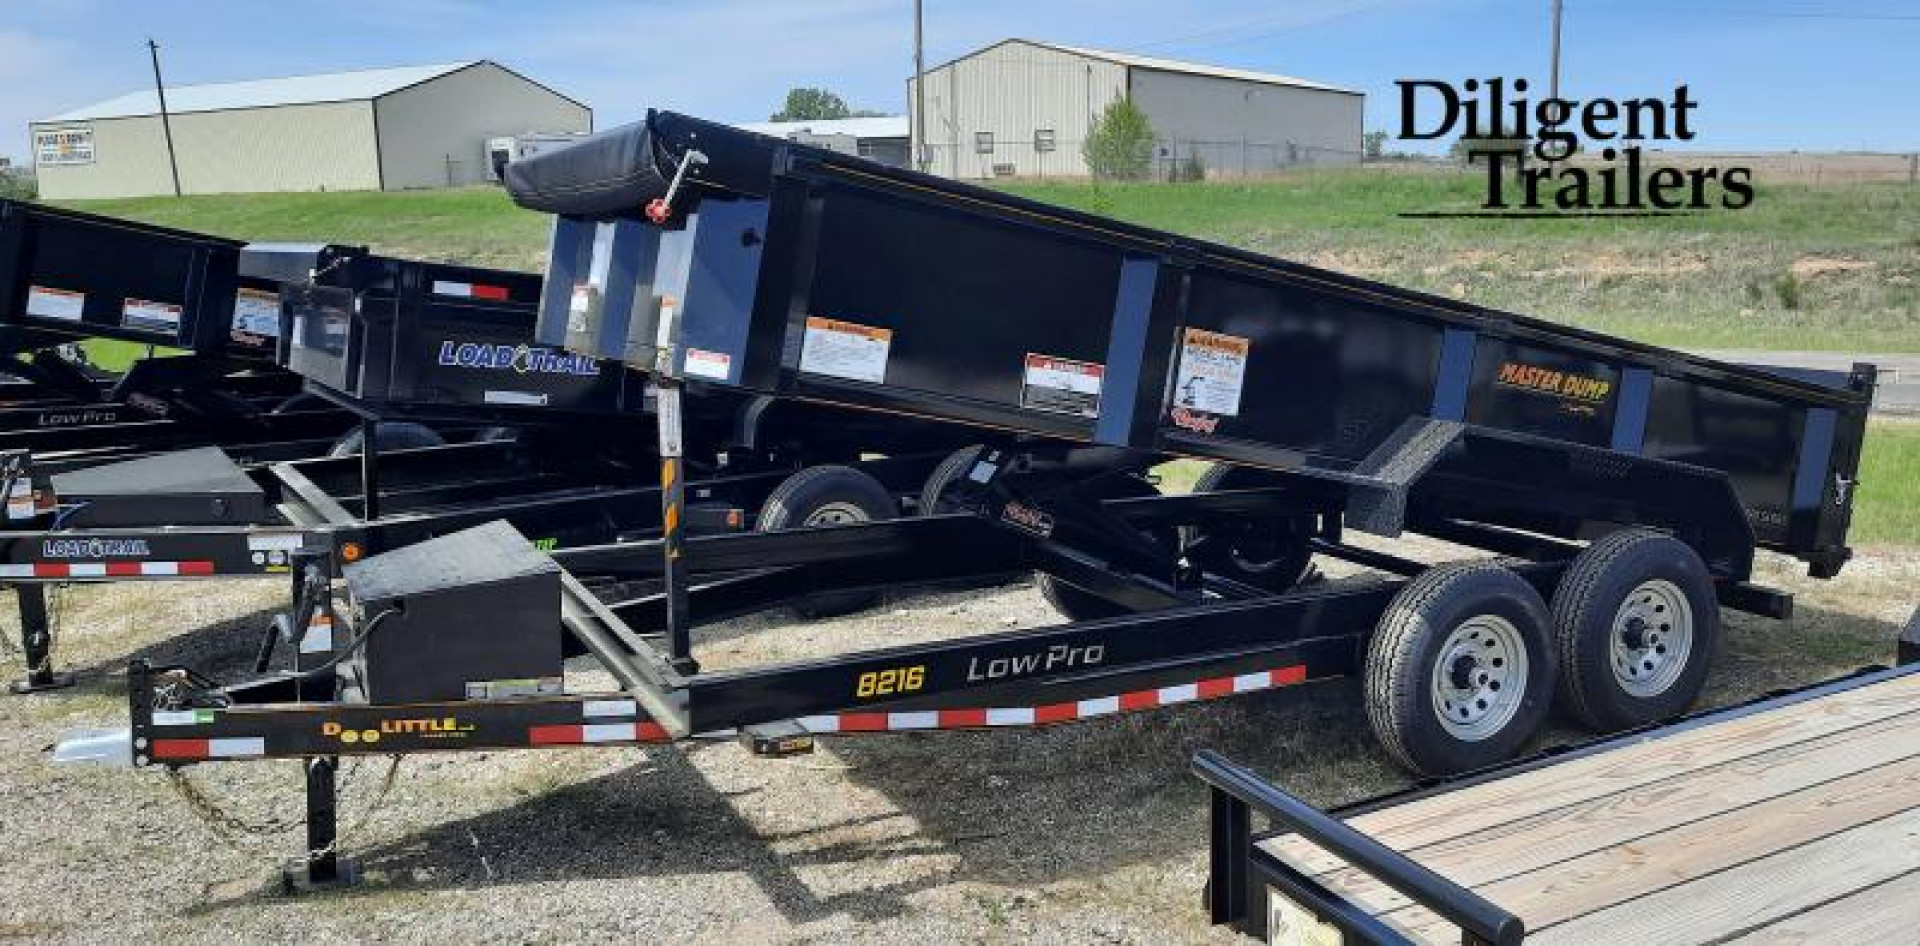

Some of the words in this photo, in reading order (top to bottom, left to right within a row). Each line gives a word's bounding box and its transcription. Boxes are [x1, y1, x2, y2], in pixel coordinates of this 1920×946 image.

[439, 340, 515, 368] LOAD
[526, 347, 600, 376] TRAIL
[1497, 363, 1562, 393] MASTER
[1564, 375, 1610, 400] DUMP
[856, 664, 926, 698] 8216
